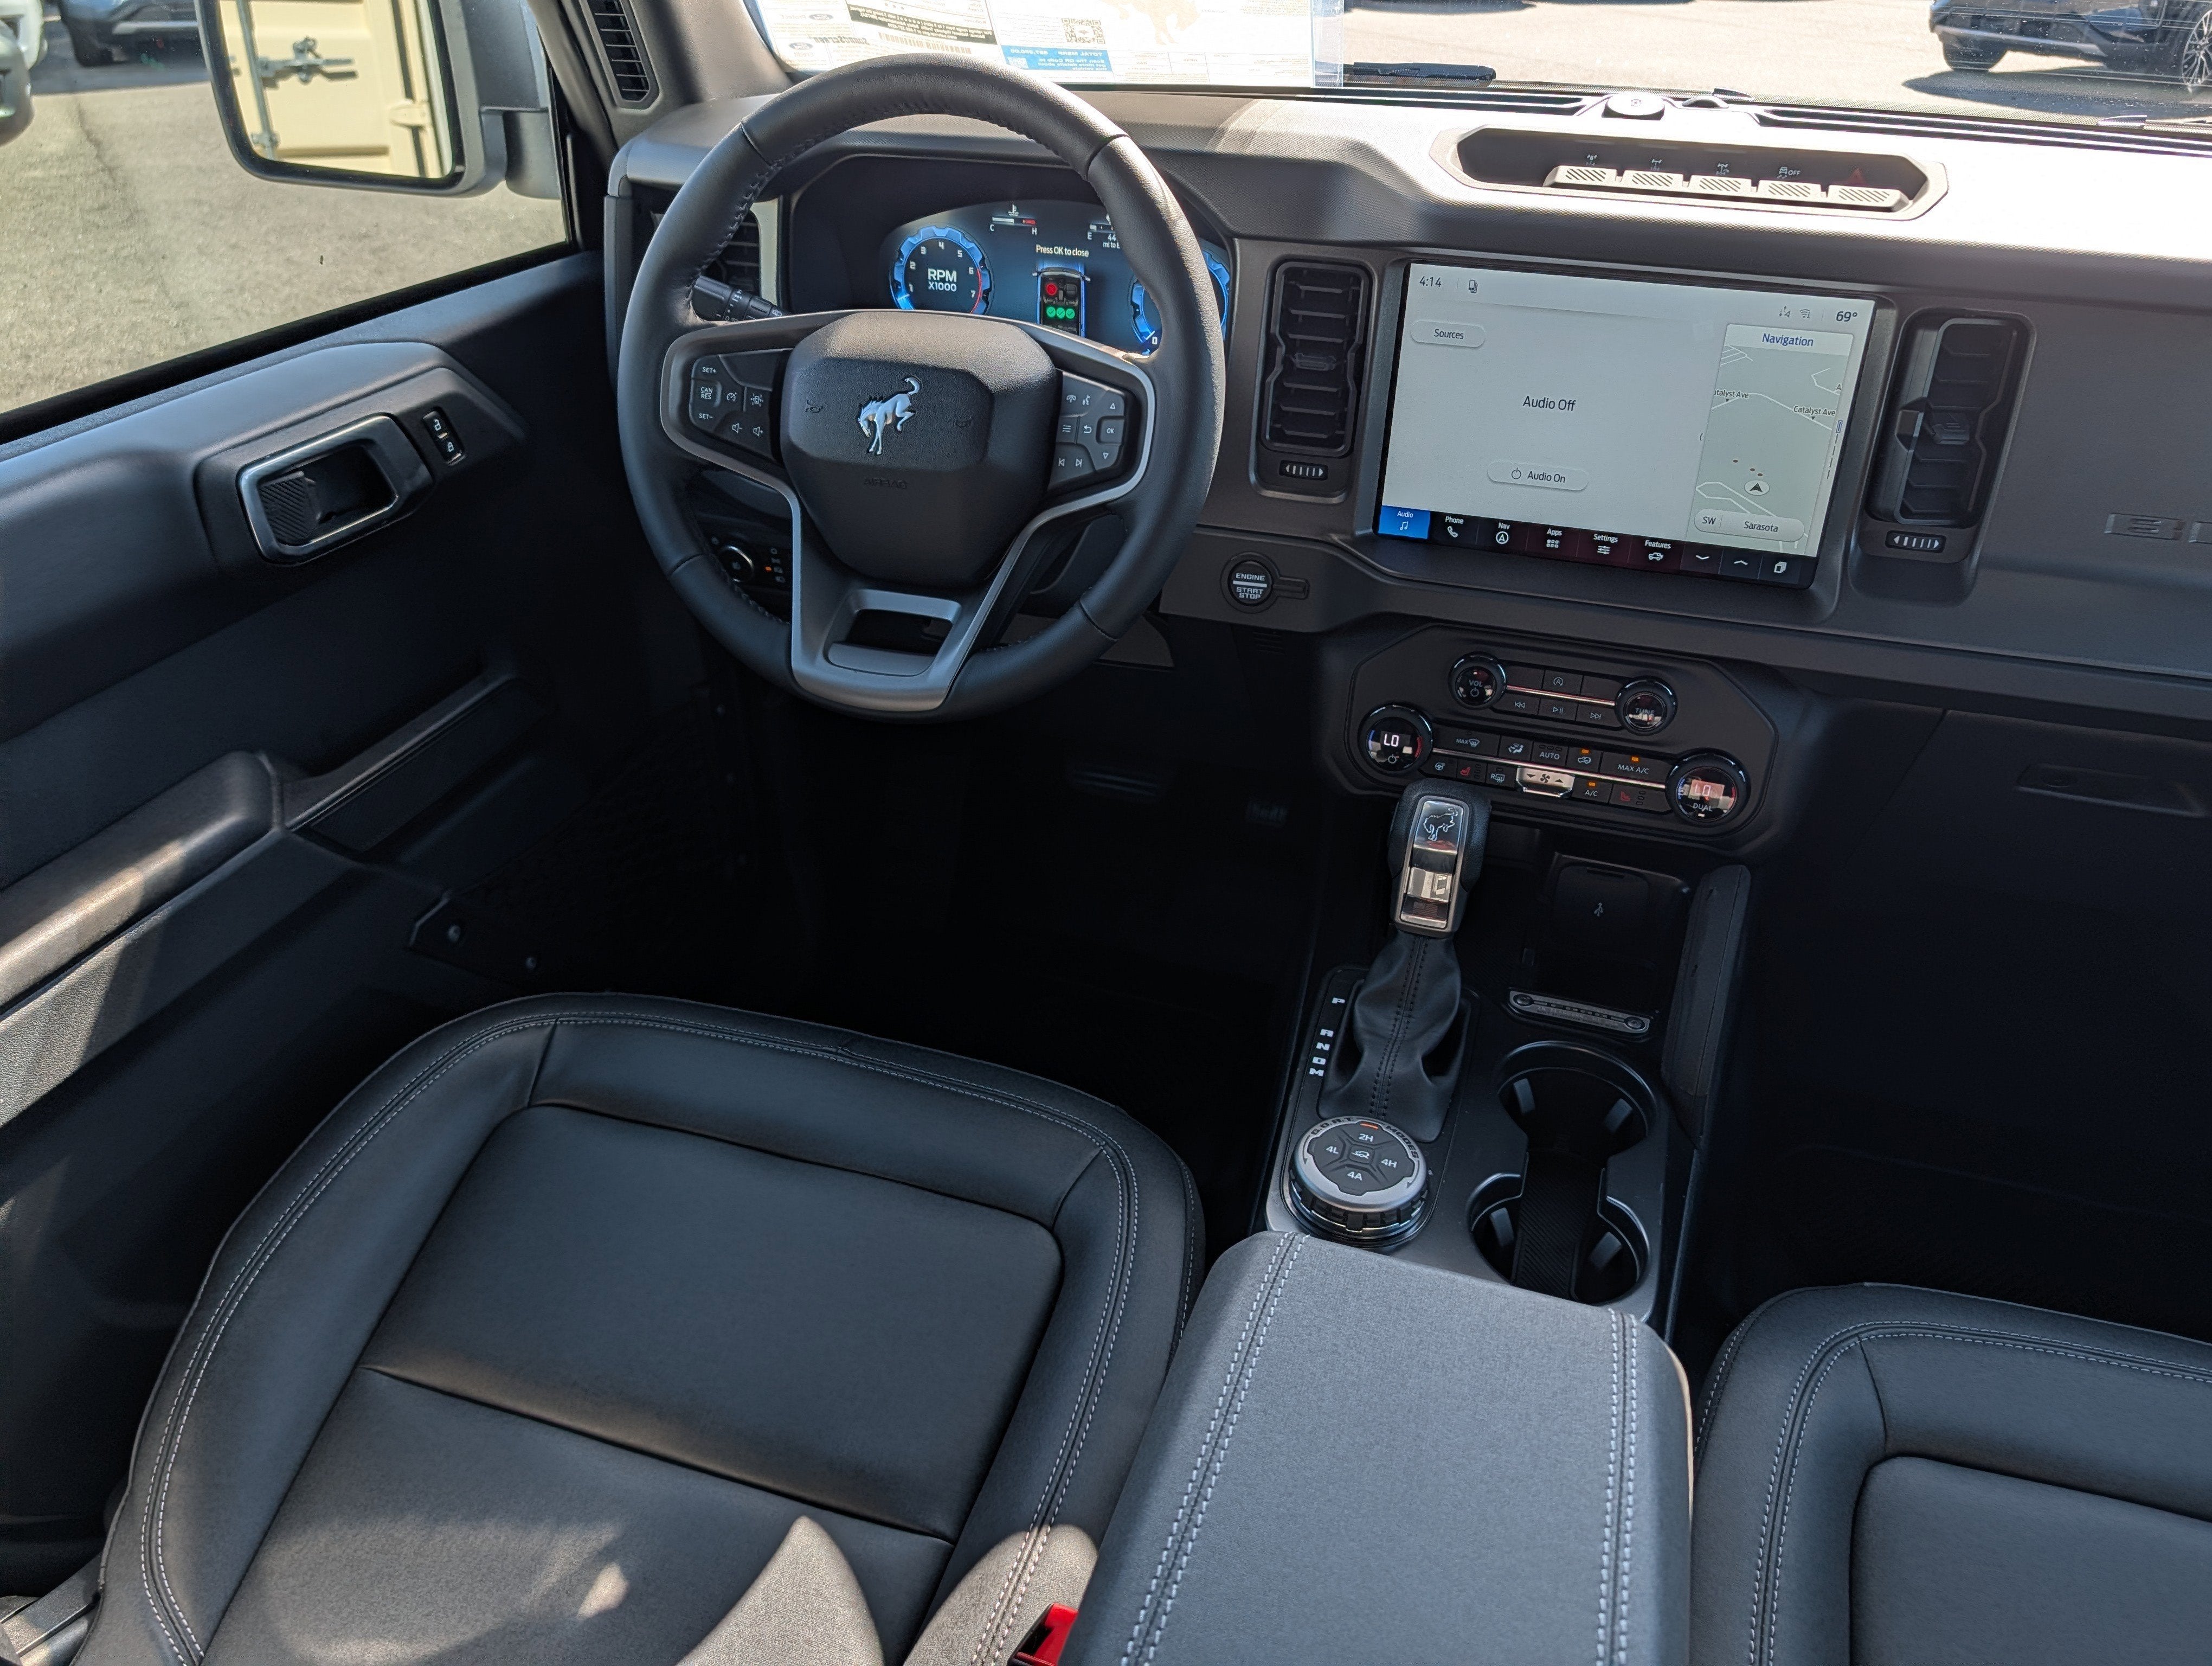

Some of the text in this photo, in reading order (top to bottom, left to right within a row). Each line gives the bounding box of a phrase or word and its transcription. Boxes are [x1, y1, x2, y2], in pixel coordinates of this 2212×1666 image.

[989, 223, 994, 232] C
[1032, 227, 1037, 235] H
[1087, 232, 1092, 240] E
[920, 246, 927, 255] 3
[938, 241, 945, 250] 4
[957, 249, 963, 258] 5
[1036, 244, 1090, 258] Press OK to close
[909, 260, 916, 270] 2
[927, 268, 957, 283] RPM
[968, 266, 974, 275] 6
[928, 280, 957, 292] X1000
[1419, 275, 1442, 288] 4:14
[908, 283, 914, 293] 1
[970, 290, 976, 298] 7
[1836, 311, 1858, 322] 69°
[1433, 328, 1464, 340] Sources
[1761, 332, 1815, 347] Navigation
[1735, 390, 1750, 399] Ave
[1522, 395, 1577, 412] Audio Off
[1793, 406, 1821, 416] Catalyst
[1527, 471, 1566, 484] Audio On
[1397, 510, 1413, 518] Audio
[1445, 515, 1464, 524] Phone
[1702, 516, 1716, 526] SW
[1497, 522, 1510, 530] Nav
[1743, 521, 1779, 533] Sarasota
[1546, 528, 1562, 538] Apps
[1593, 533, 1619, 544] Settings
[1644, 539, 1673, 549] Features
[1236, 572, 1265, 581] ENGINE
[1236, 586, 1264, 594] START
[1469, 679, 1483, 688] VOL
[1383, 733, 1400, 747] LO
[1539, 752, 1560, 760] AUTO
[1617, 764, 1634, 772] MAX
[1694, 783, 1712, 797] LO
[1692, 803, 1713, 812] DUAL
[1319, 1028, 1334, 1038] R
[1315, 1041, 1330, 1051] N
[1311, 1056, 1327, 1066] D
[1308, 1067, 1324, 1077] M
[1358, 1133, 1374, 1142] 2H
[1386, 1124, 1420, 1159] MODES
[1326, 1146, 1339, 1155] 4L
[1380, 1158, 1398, 1169] 4H
[1347, 1171, 1363, 1181] 4A
